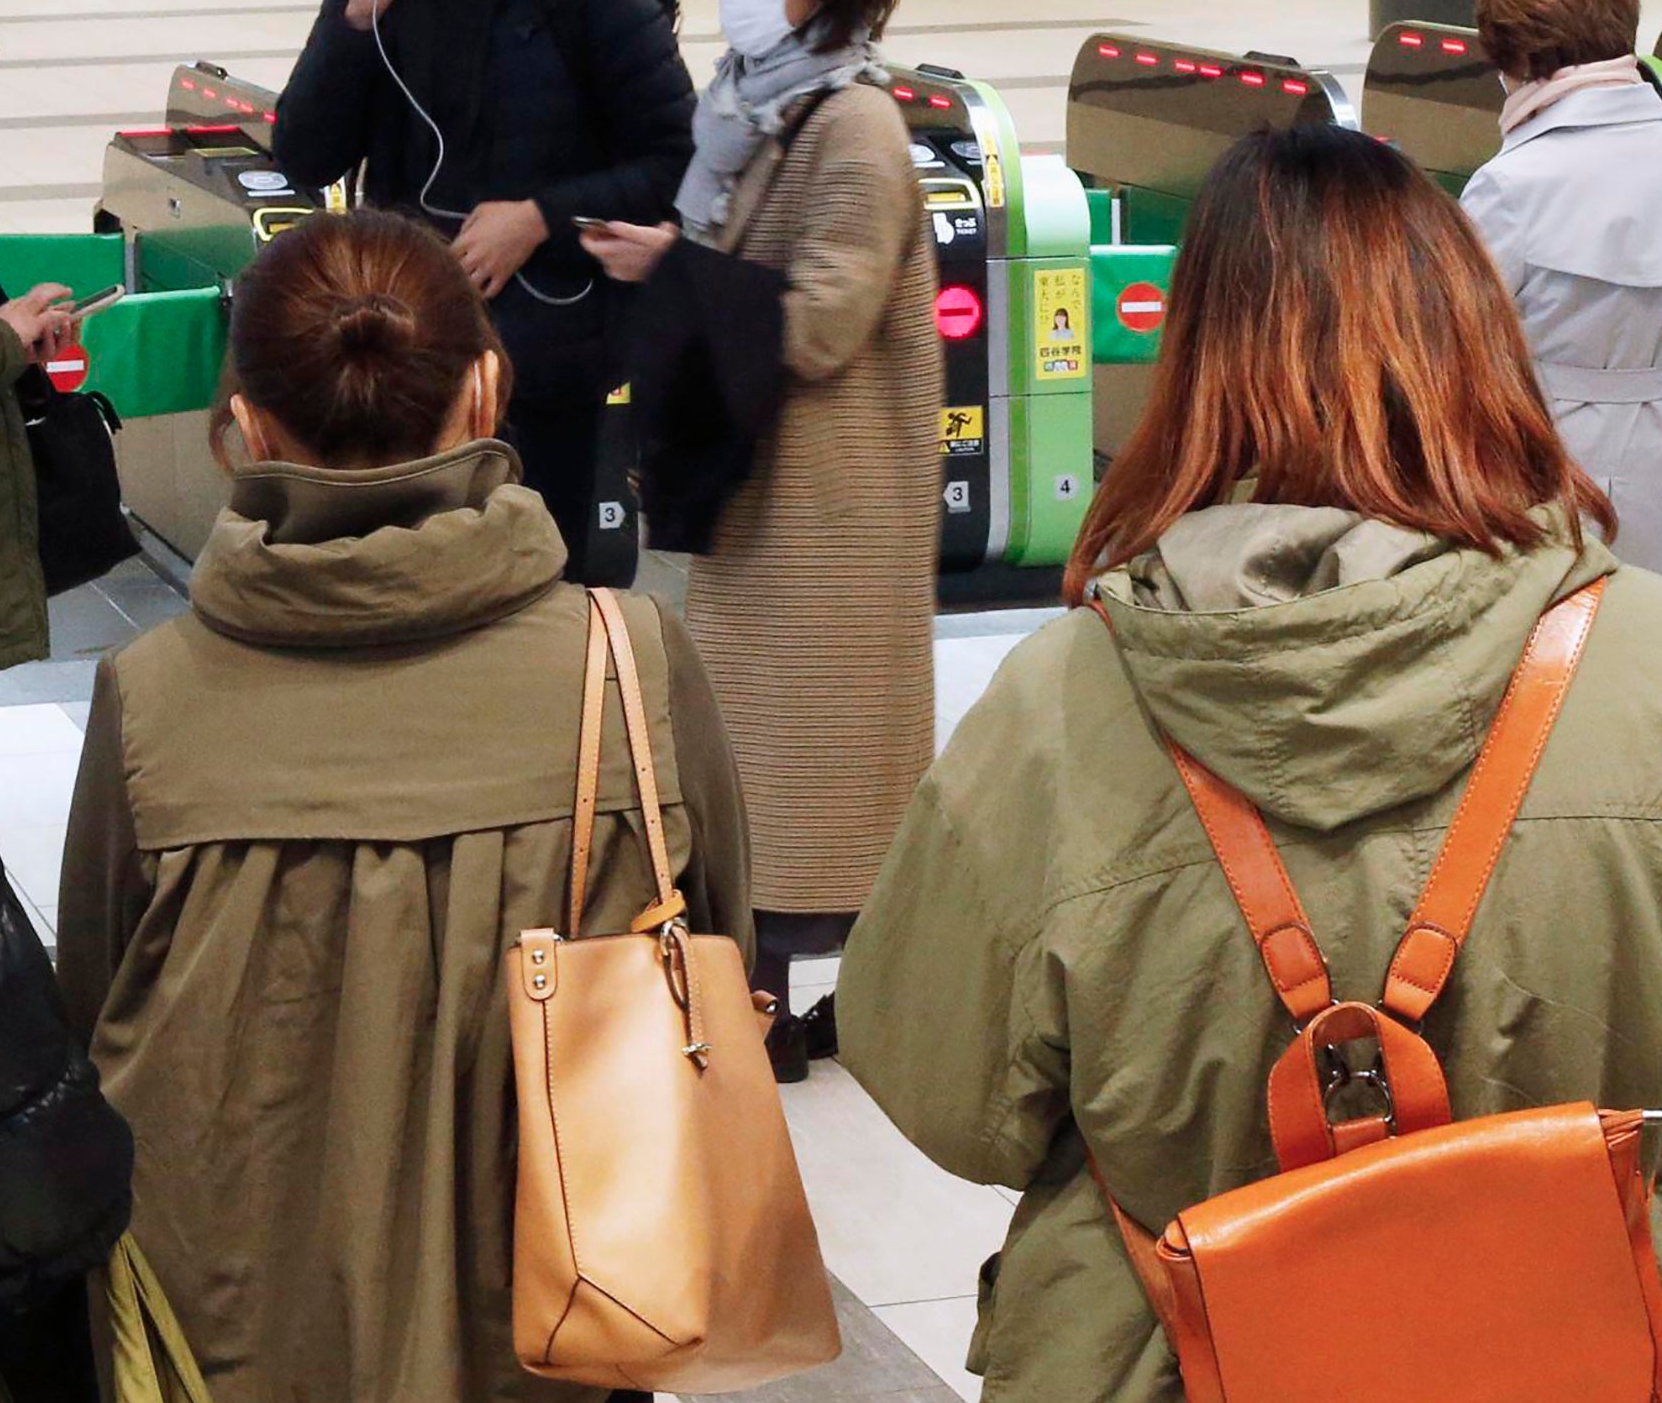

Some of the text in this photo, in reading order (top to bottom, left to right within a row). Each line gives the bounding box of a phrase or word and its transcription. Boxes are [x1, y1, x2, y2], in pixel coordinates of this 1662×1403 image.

[1059, 479, 1071, 494] 4
[952, 487, 964, 502] 3
[604, 506, 616, 524] 3
